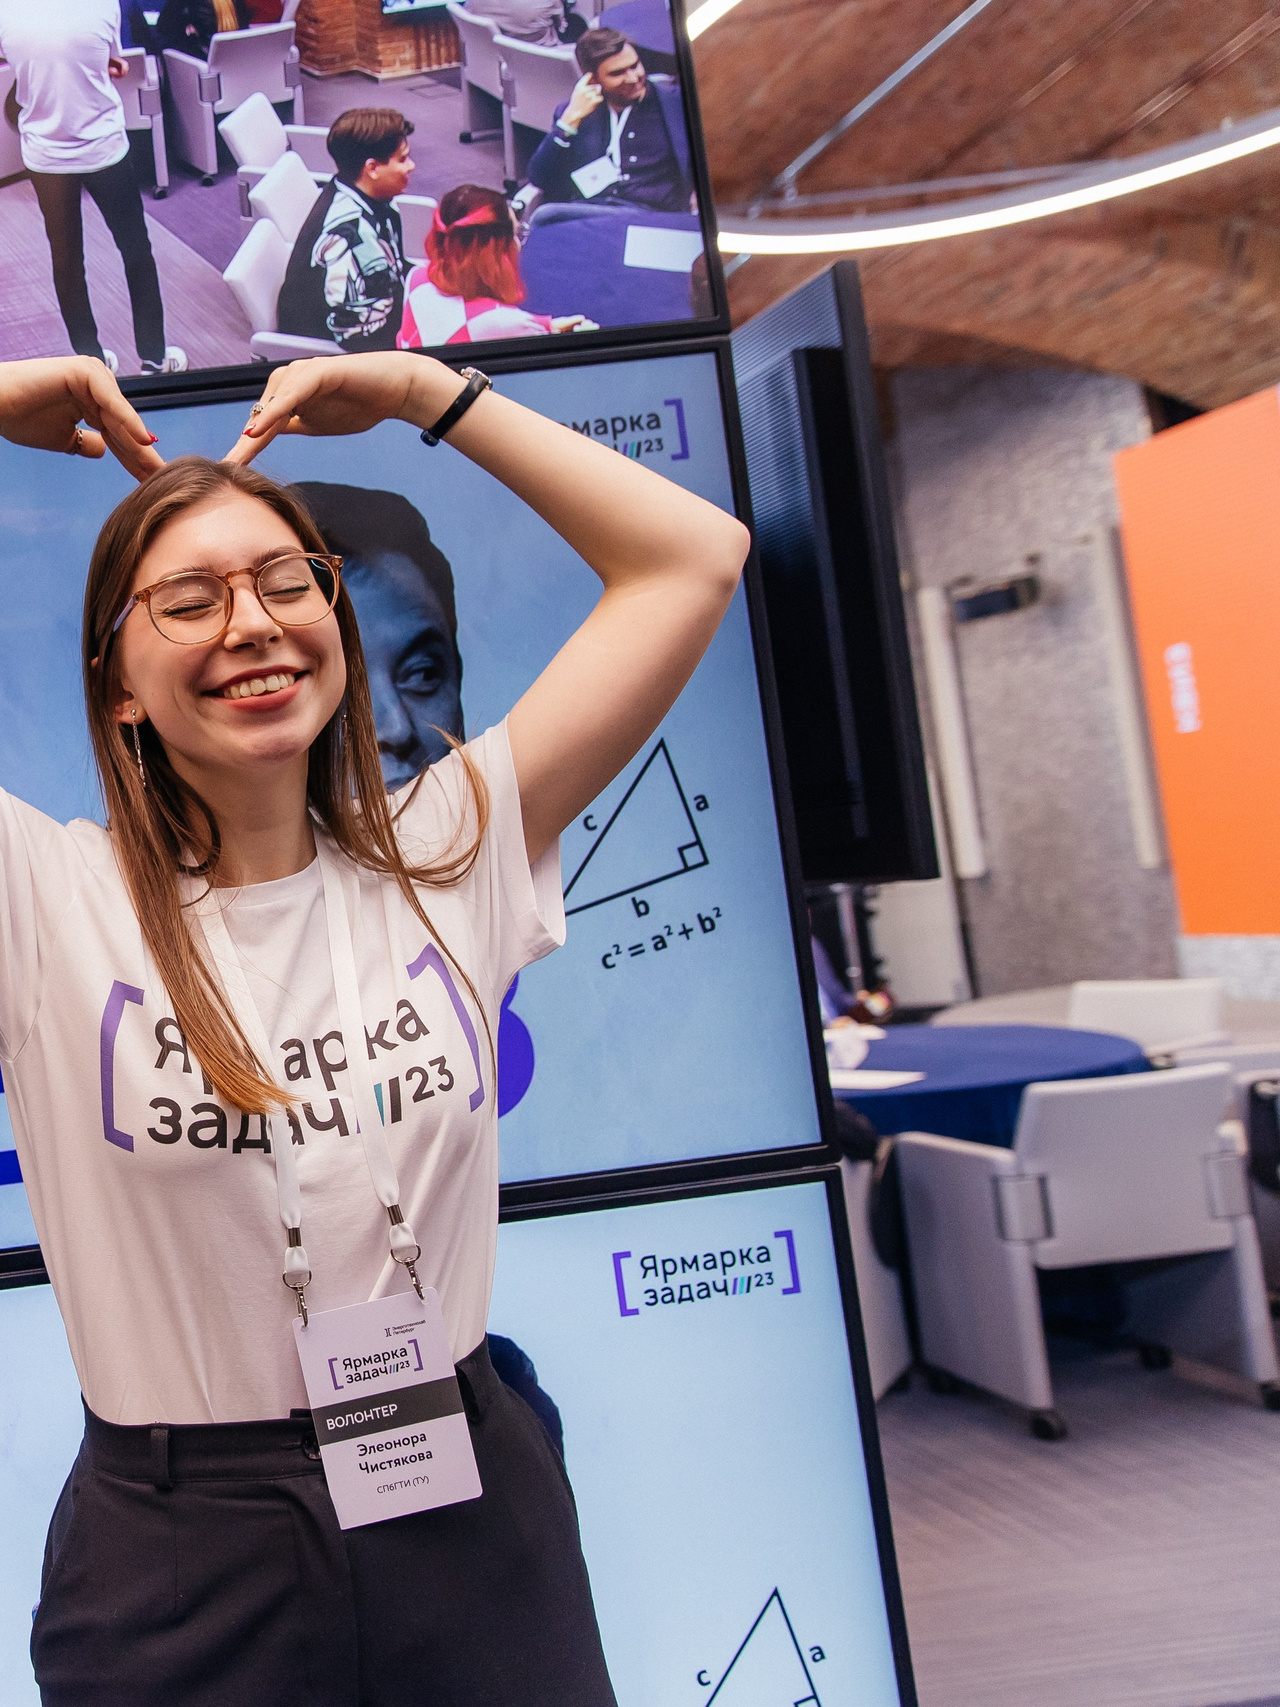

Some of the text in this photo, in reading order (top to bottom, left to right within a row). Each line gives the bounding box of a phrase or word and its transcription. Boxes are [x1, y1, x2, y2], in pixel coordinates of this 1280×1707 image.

[558, 412, 661, 440] марка
[693, 794, 709, 812] a
[583, 814, 598, 831] c
[631, 897, 650, 918] b
[640, 1245, 771, 1284] Ярмарка
[342, 1347, 408, 1372] Ярмарка
[326, 1403, 398, 1431] ВОЛОНТЕР
[357, 1432, 427, 1456] Элеонора
[359, 1450, 433, 1474] Чистякова
[412, 1475, 430, 1488] (ТУ)
[809, 1645, 826, 1663] a
[696, 1670, 711, 1686] c
